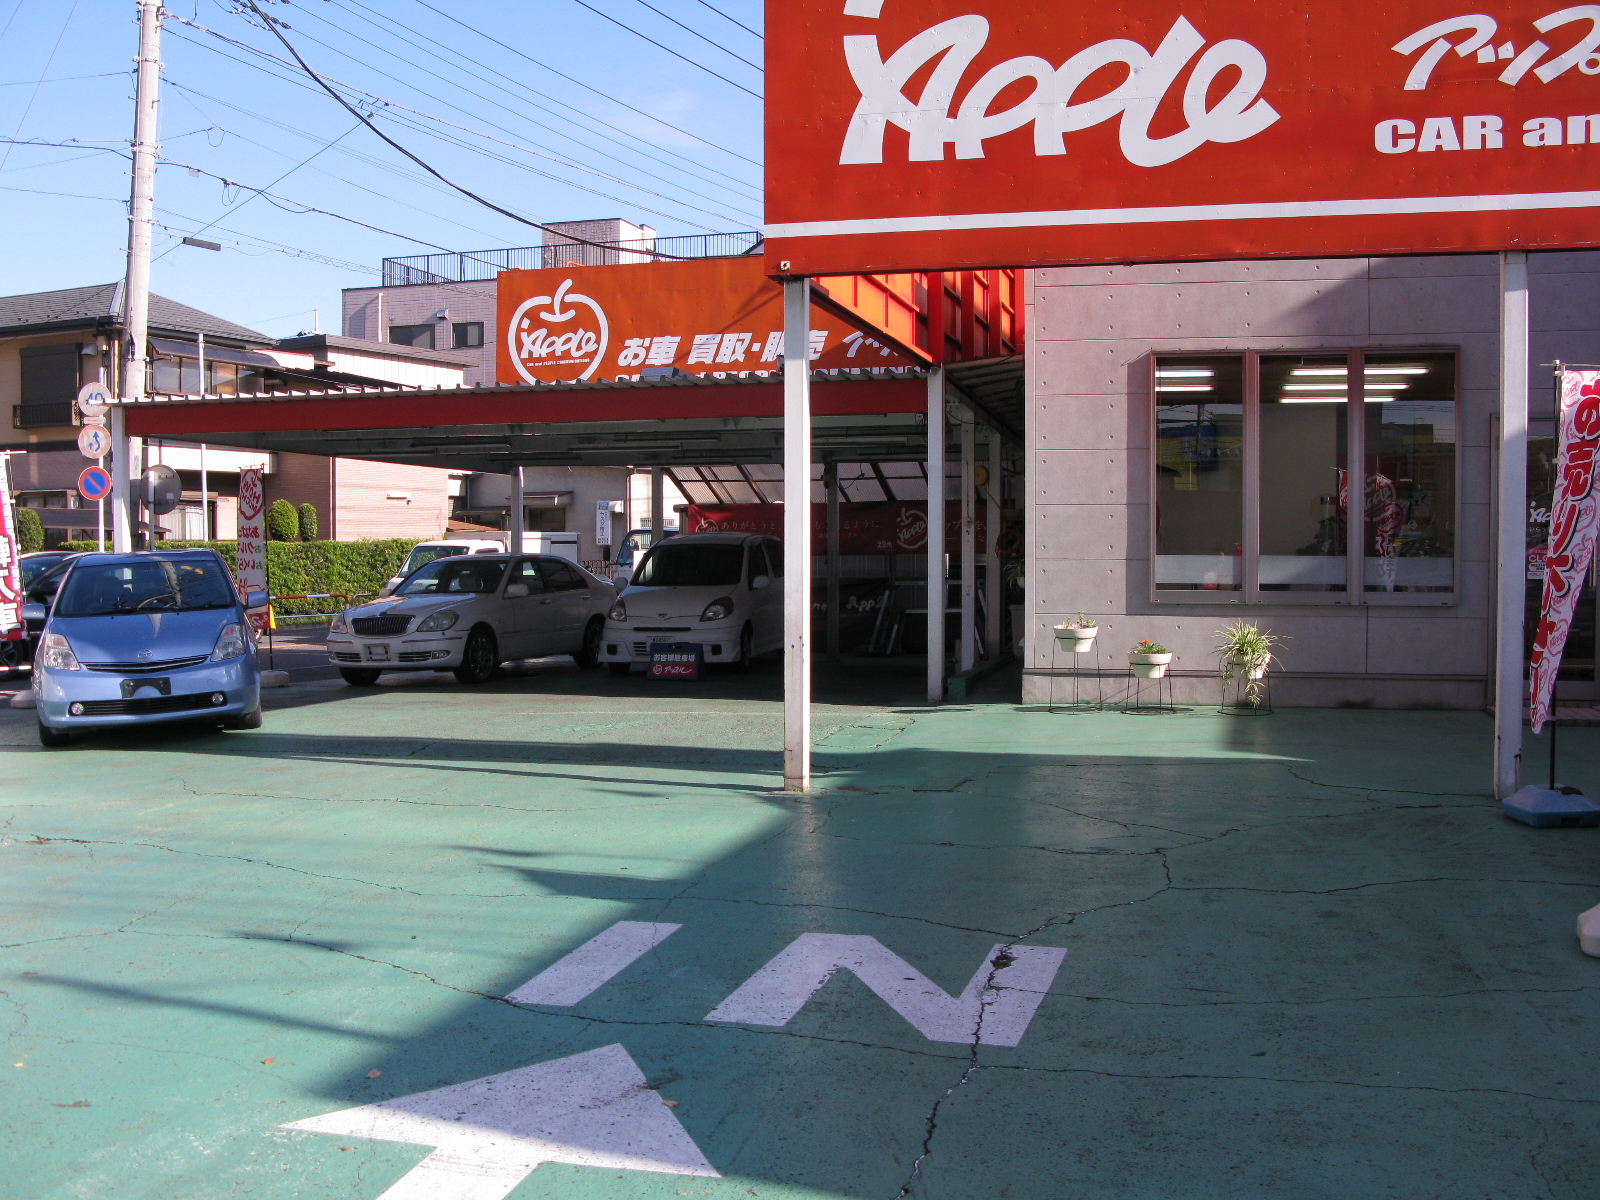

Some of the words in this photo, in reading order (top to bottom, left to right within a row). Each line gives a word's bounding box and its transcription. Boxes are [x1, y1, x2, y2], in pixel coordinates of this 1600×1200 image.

[1374, 115, 1503, 154] CAR
[617, 335, 681, 367] お車
[502, 920, 1068, 1048] IN
